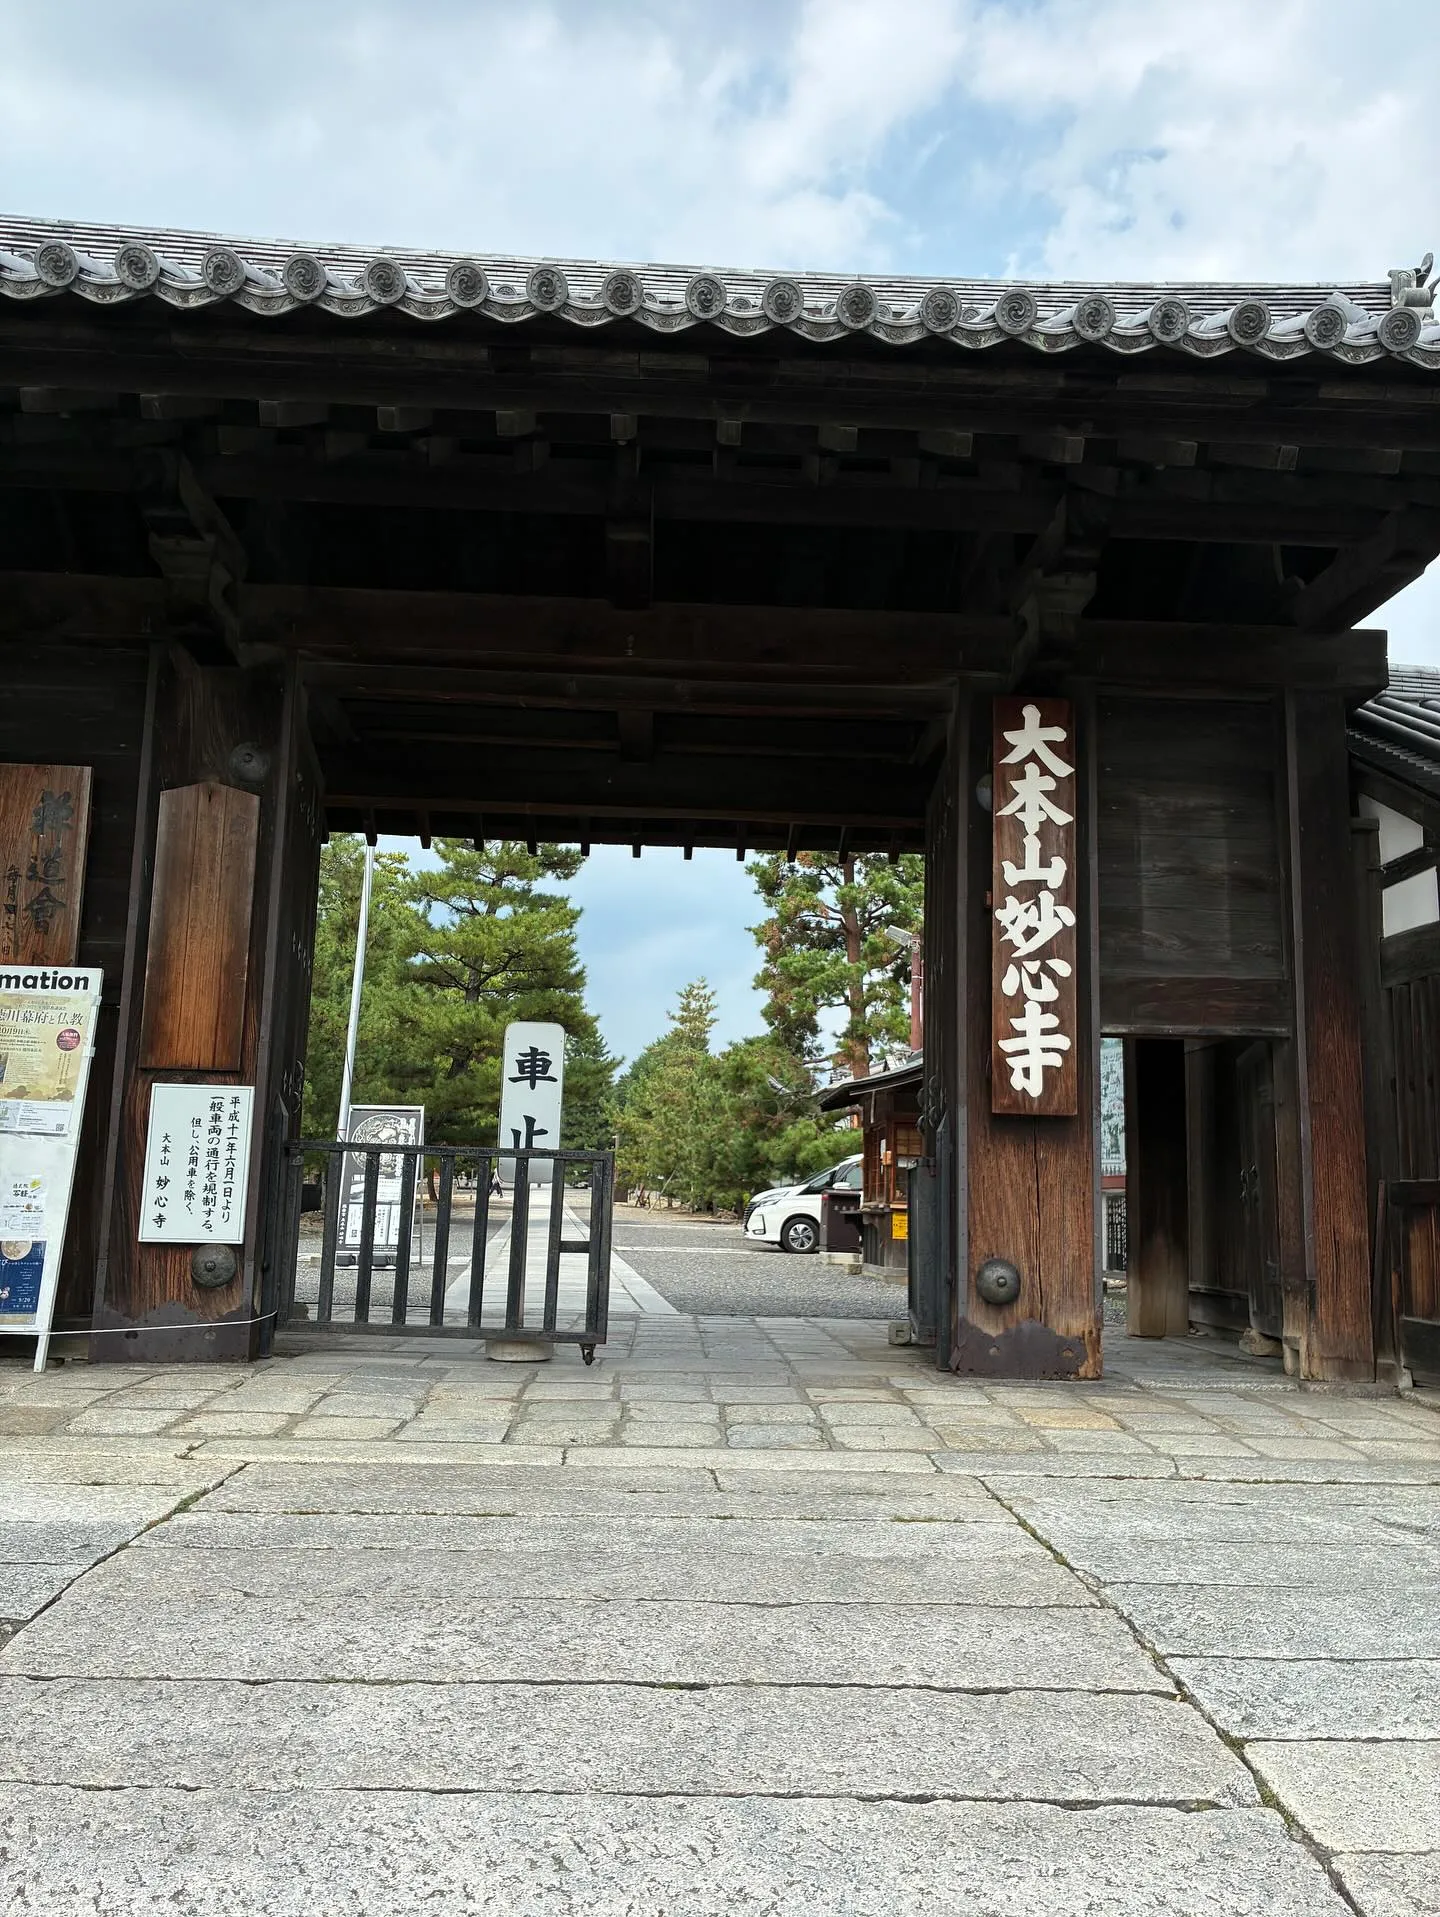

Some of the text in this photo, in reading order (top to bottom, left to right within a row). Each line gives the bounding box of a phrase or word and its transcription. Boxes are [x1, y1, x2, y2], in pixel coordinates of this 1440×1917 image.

[995, 704, 1076, 1097] 大本山妙心寺
[222, 1096, 241, 1223] 平成十一年六月一日より
[508, 1046, 558, 1150] 車止
[152, 1133, 171, 1228] 大本山 妙心寺
[201, 1096, 225, 1232] 一般車両の通行を規制する。
